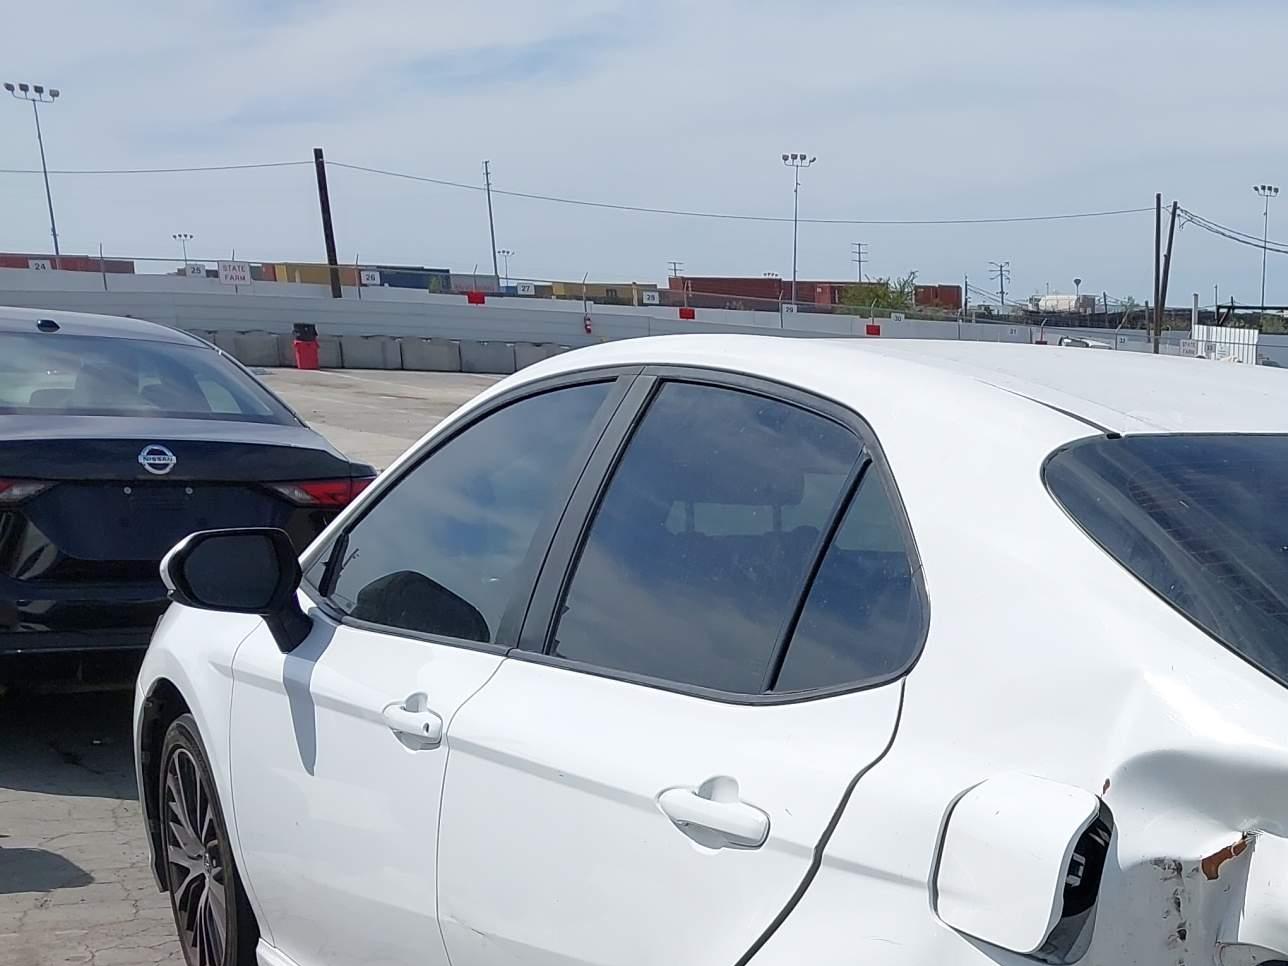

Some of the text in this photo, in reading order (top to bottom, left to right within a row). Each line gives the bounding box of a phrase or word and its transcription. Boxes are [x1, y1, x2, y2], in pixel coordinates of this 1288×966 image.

[34, 262, 46, 271] 24
[222, 264, 246, 272] STATE
[224, 273, 246, 281] FARM
[366, 273, 376, 281] 26
